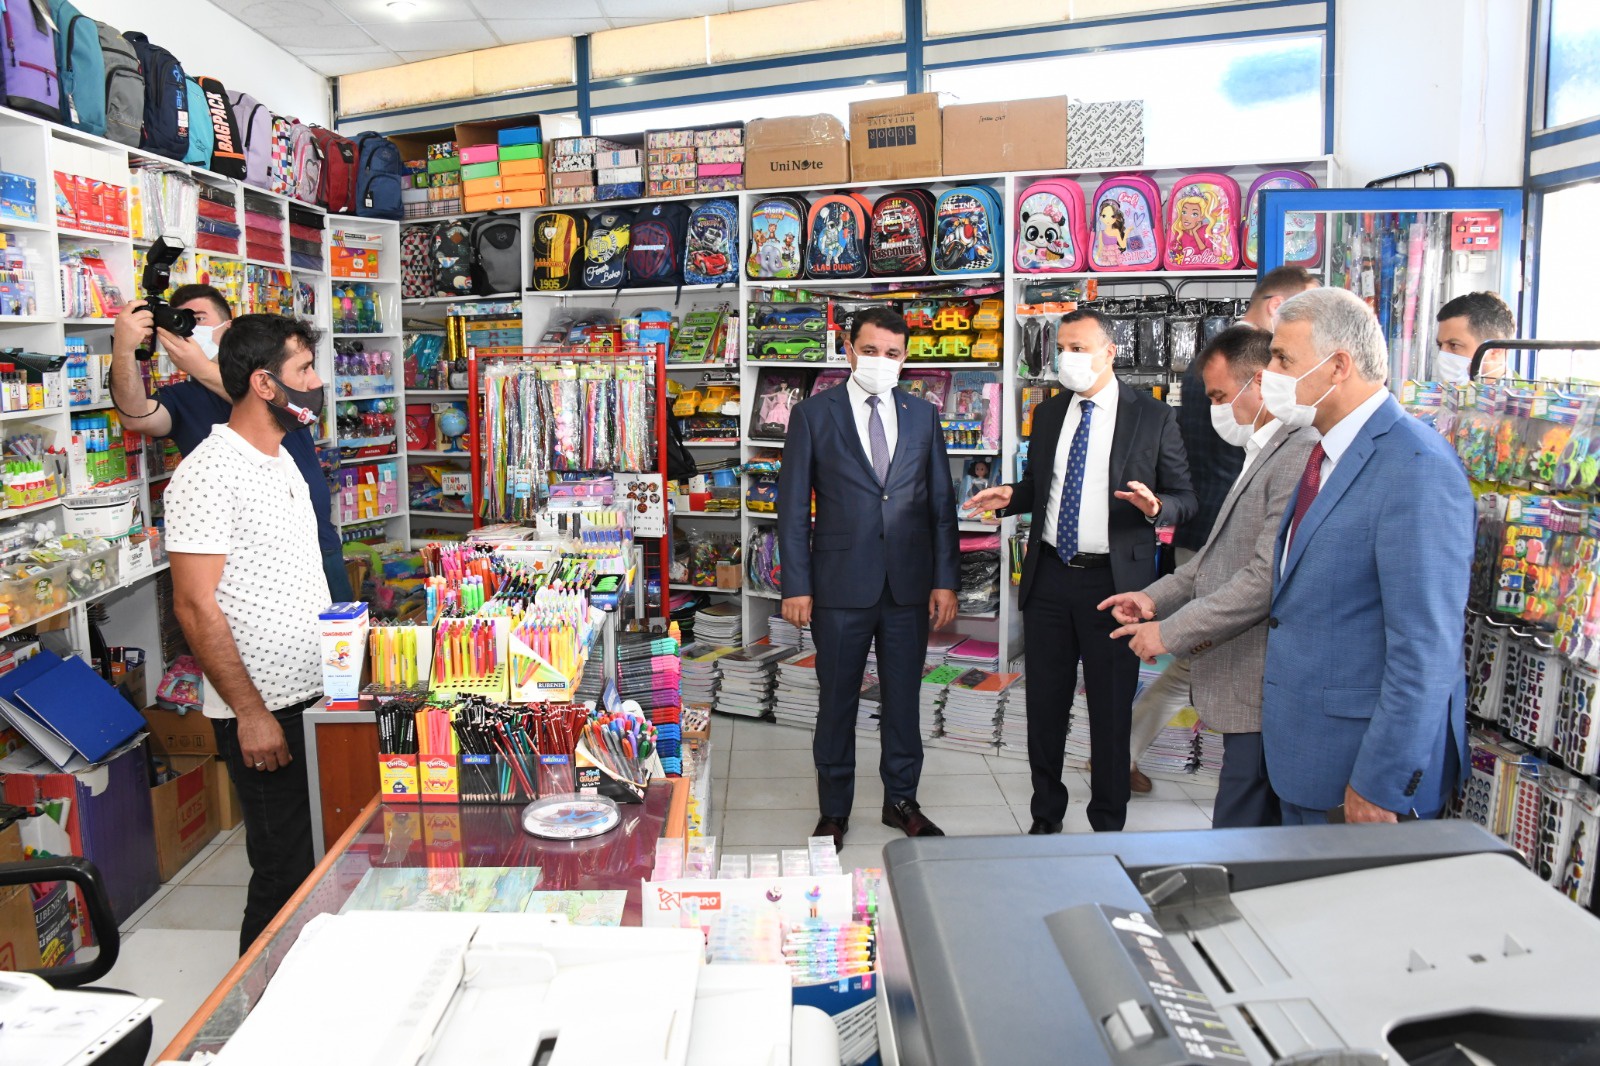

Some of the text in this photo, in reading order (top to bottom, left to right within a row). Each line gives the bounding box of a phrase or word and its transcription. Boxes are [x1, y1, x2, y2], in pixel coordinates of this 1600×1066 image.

[206, 91, 234, 153] BAGPACK
[539, 278, 560, 290] 1905
[443, 476, 460, 484] ATOM
[1520, 525, 1543, 538] FIFA
